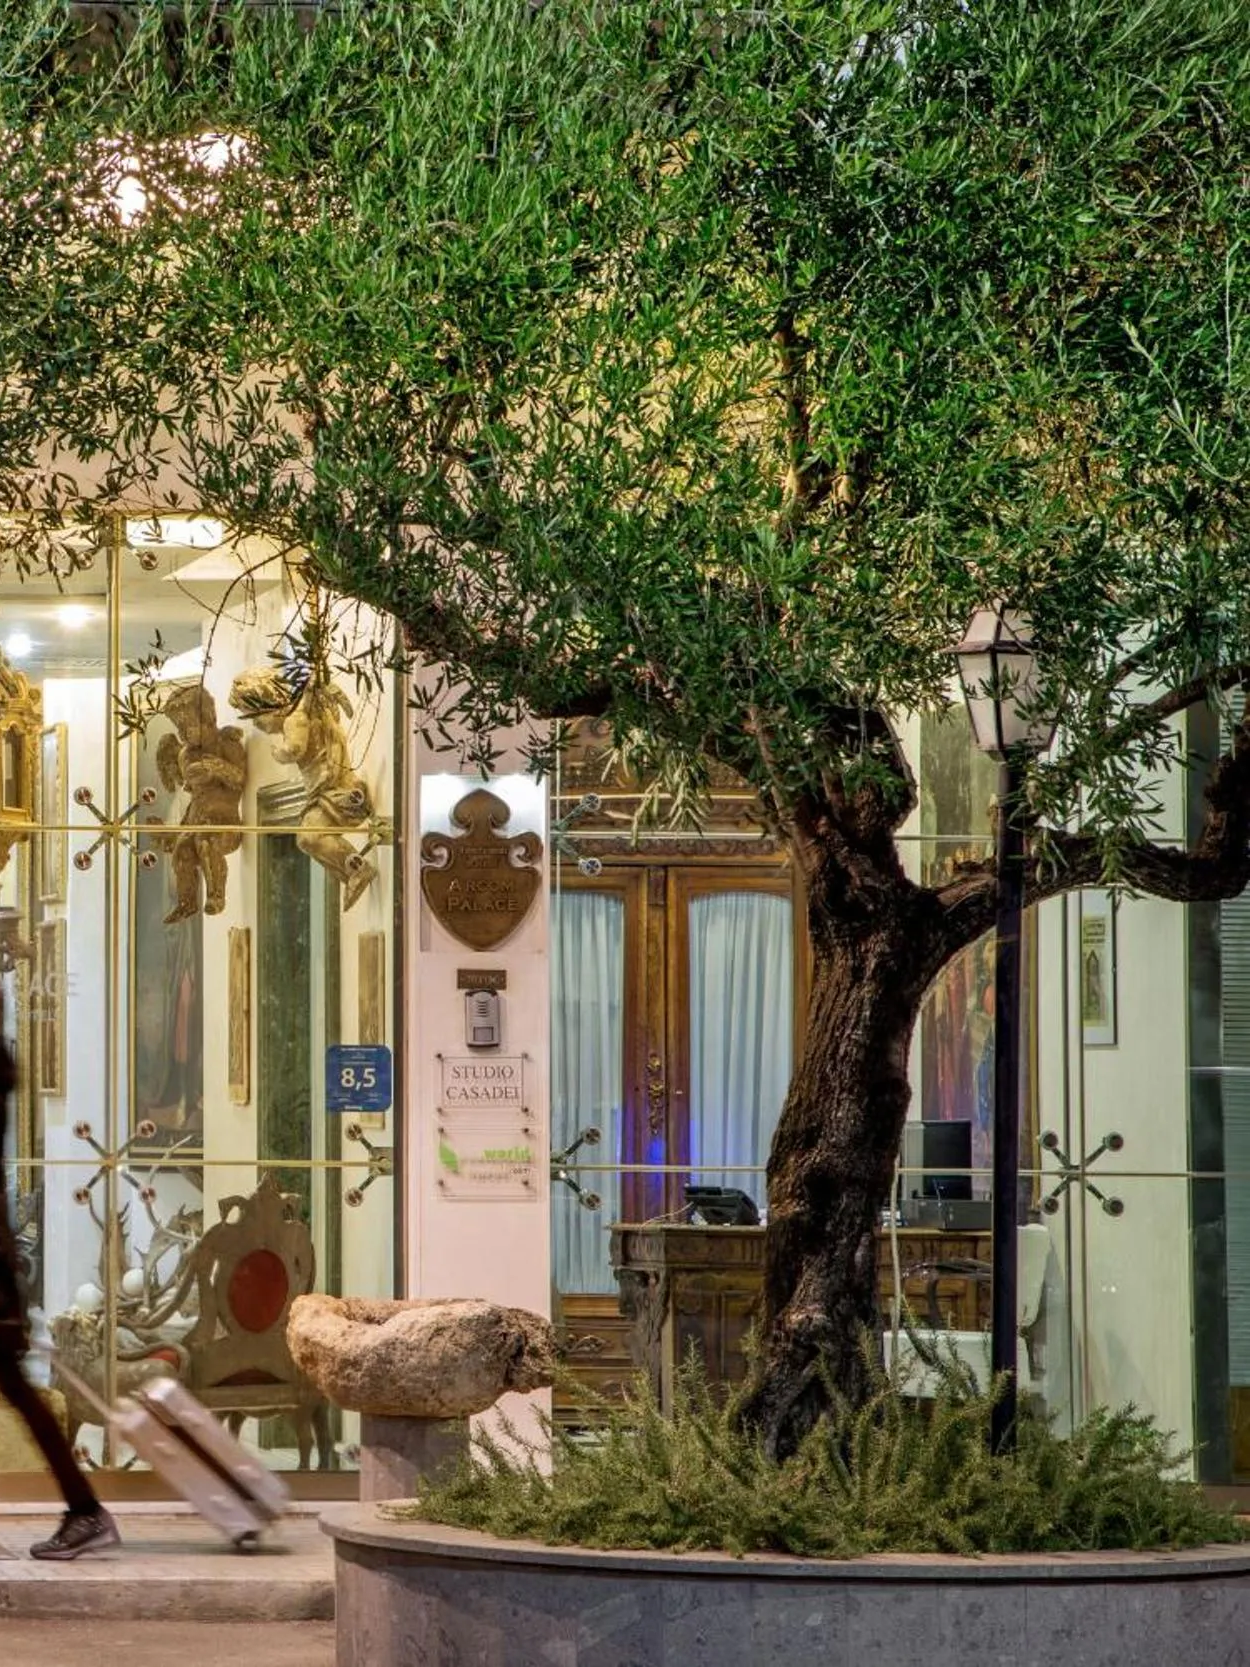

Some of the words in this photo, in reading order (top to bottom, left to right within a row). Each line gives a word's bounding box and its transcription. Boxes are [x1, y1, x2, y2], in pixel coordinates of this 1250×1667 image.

[452, 1065, 514, 1079] STUDIO
[341, 1068, 376, 1091] 8,5
[446, 1086, 519, 1100] CASADEI
